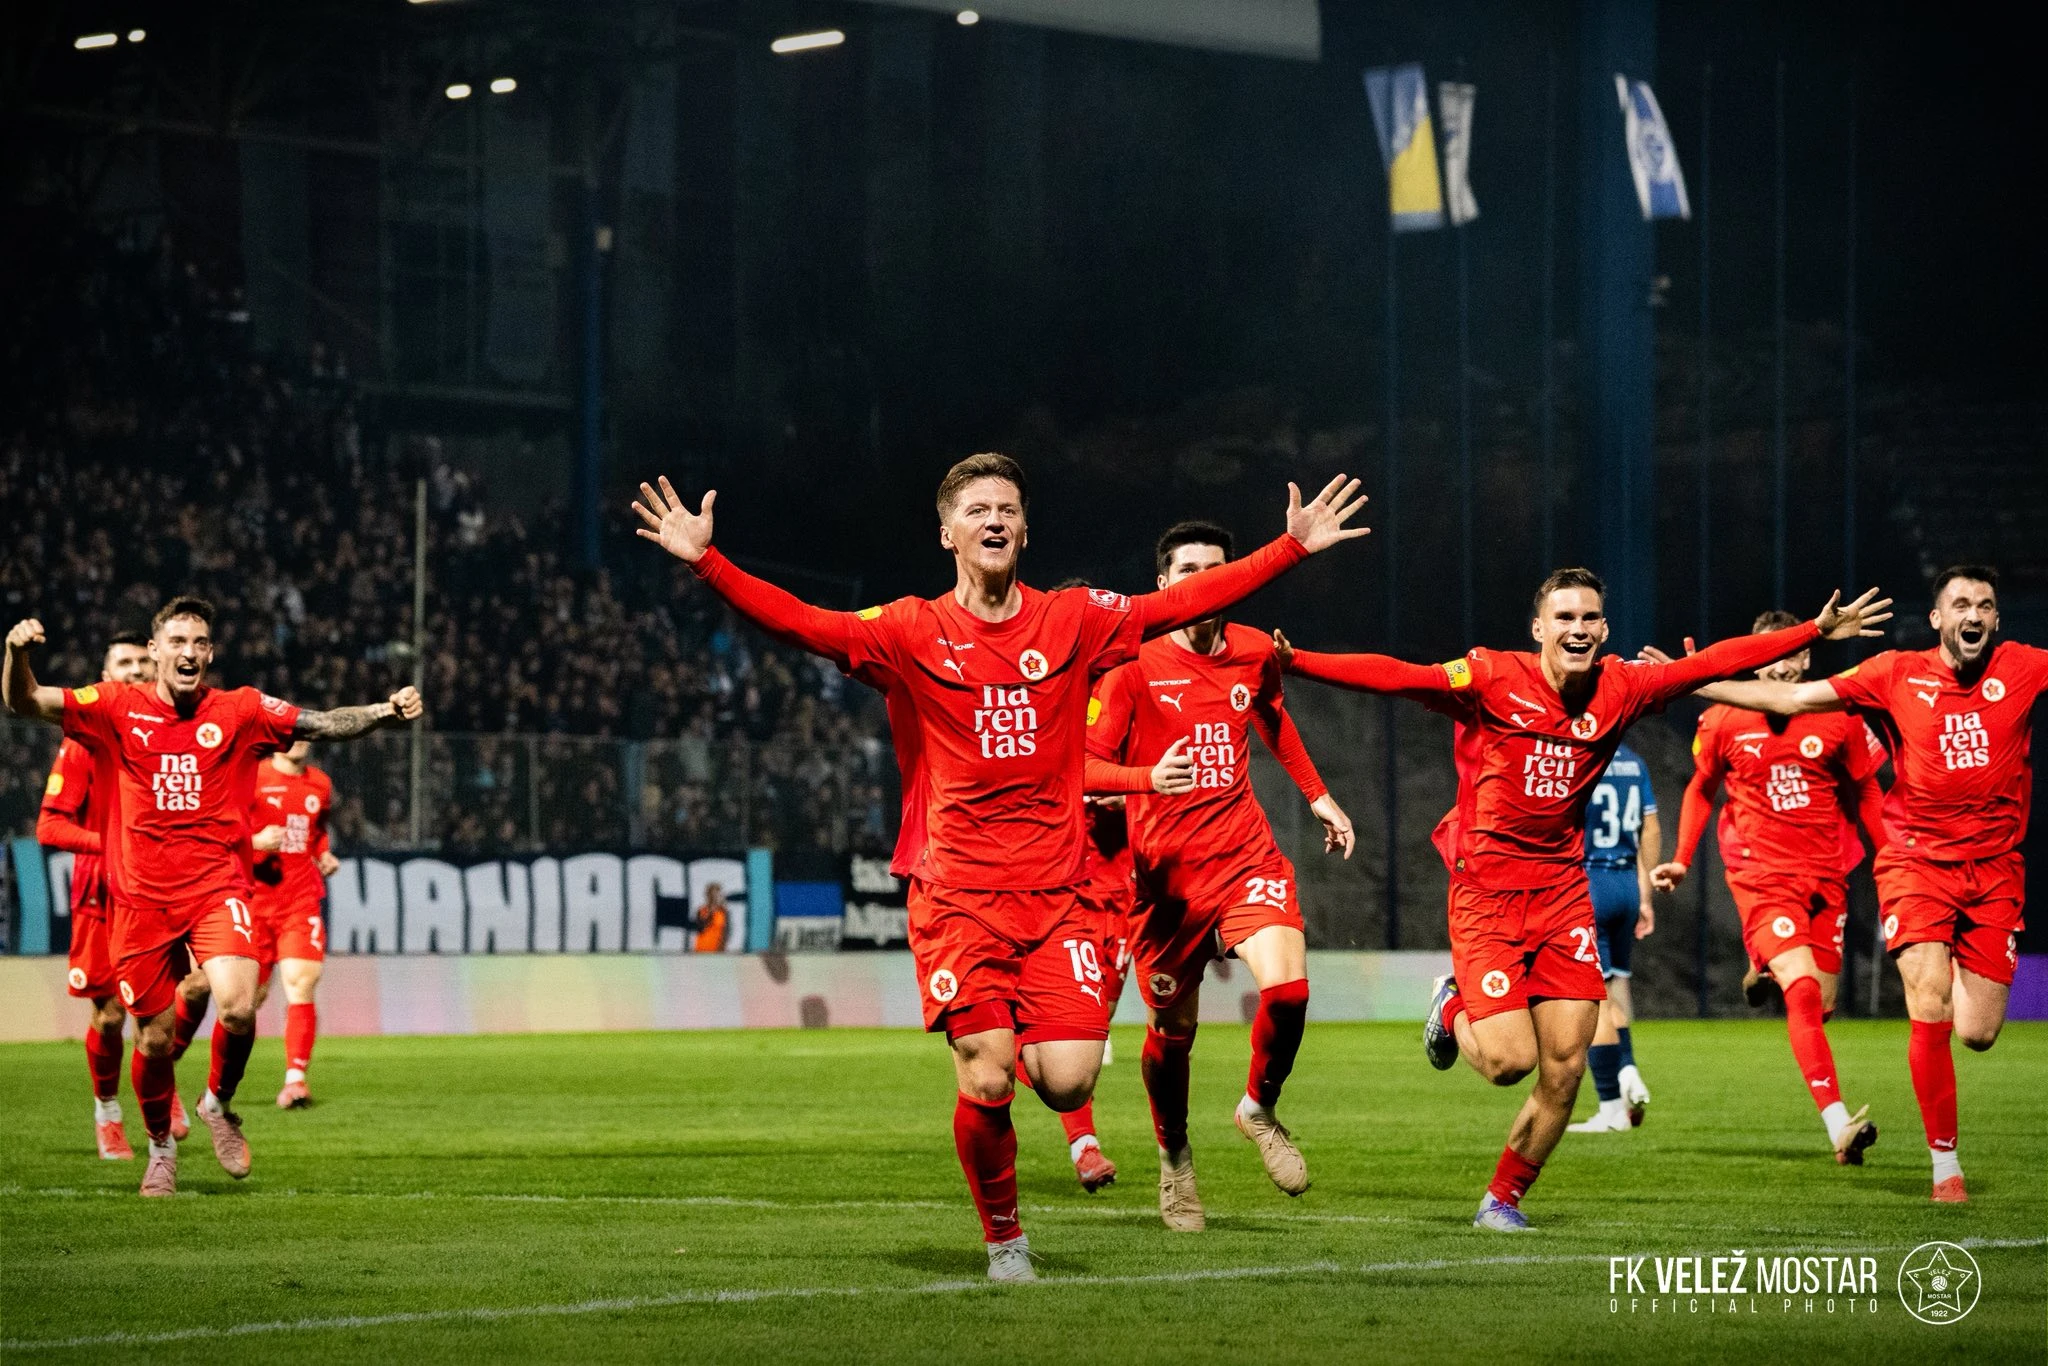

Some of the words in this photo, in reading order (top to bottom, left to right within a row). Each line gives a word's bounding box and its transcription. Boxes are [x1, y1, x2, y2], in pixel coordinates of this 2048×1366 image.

[983, 684, 1031, 708] na
[974, 706, 1038, 733] ren
[1943, 711, 1983, 733] na
[978, 727, 1037, 759] tas
[1194, 722, 1231, 745] na
[1938, 728, 1990, 752] ren
[1186, 744, 1236, 767] ren
[1534, 735, 1573, 759] na
[1943, 746, 1990, 771] tas
[161, 753, 200, 774] na
[1191, 762, 1235, 789] tas
[1523, 754, 1576, 778] ren
[1770, 763, 1803, 781] na
[152, 772, 203, 792] ren
[1524, 770, 1570, 799] tas
[1766, 779, 1810, 797] ren
[154, 786, 201, 812] tas
[1770, 793, 1811, 812] tas
[1592, 783, 1642, 848] 34
[225, 897, 252, 927] 11
[328, 852, 748, 954] MANIACS
[1569, 926, 1600, 962] 2
[1063, 939, 1102, 983] 19
